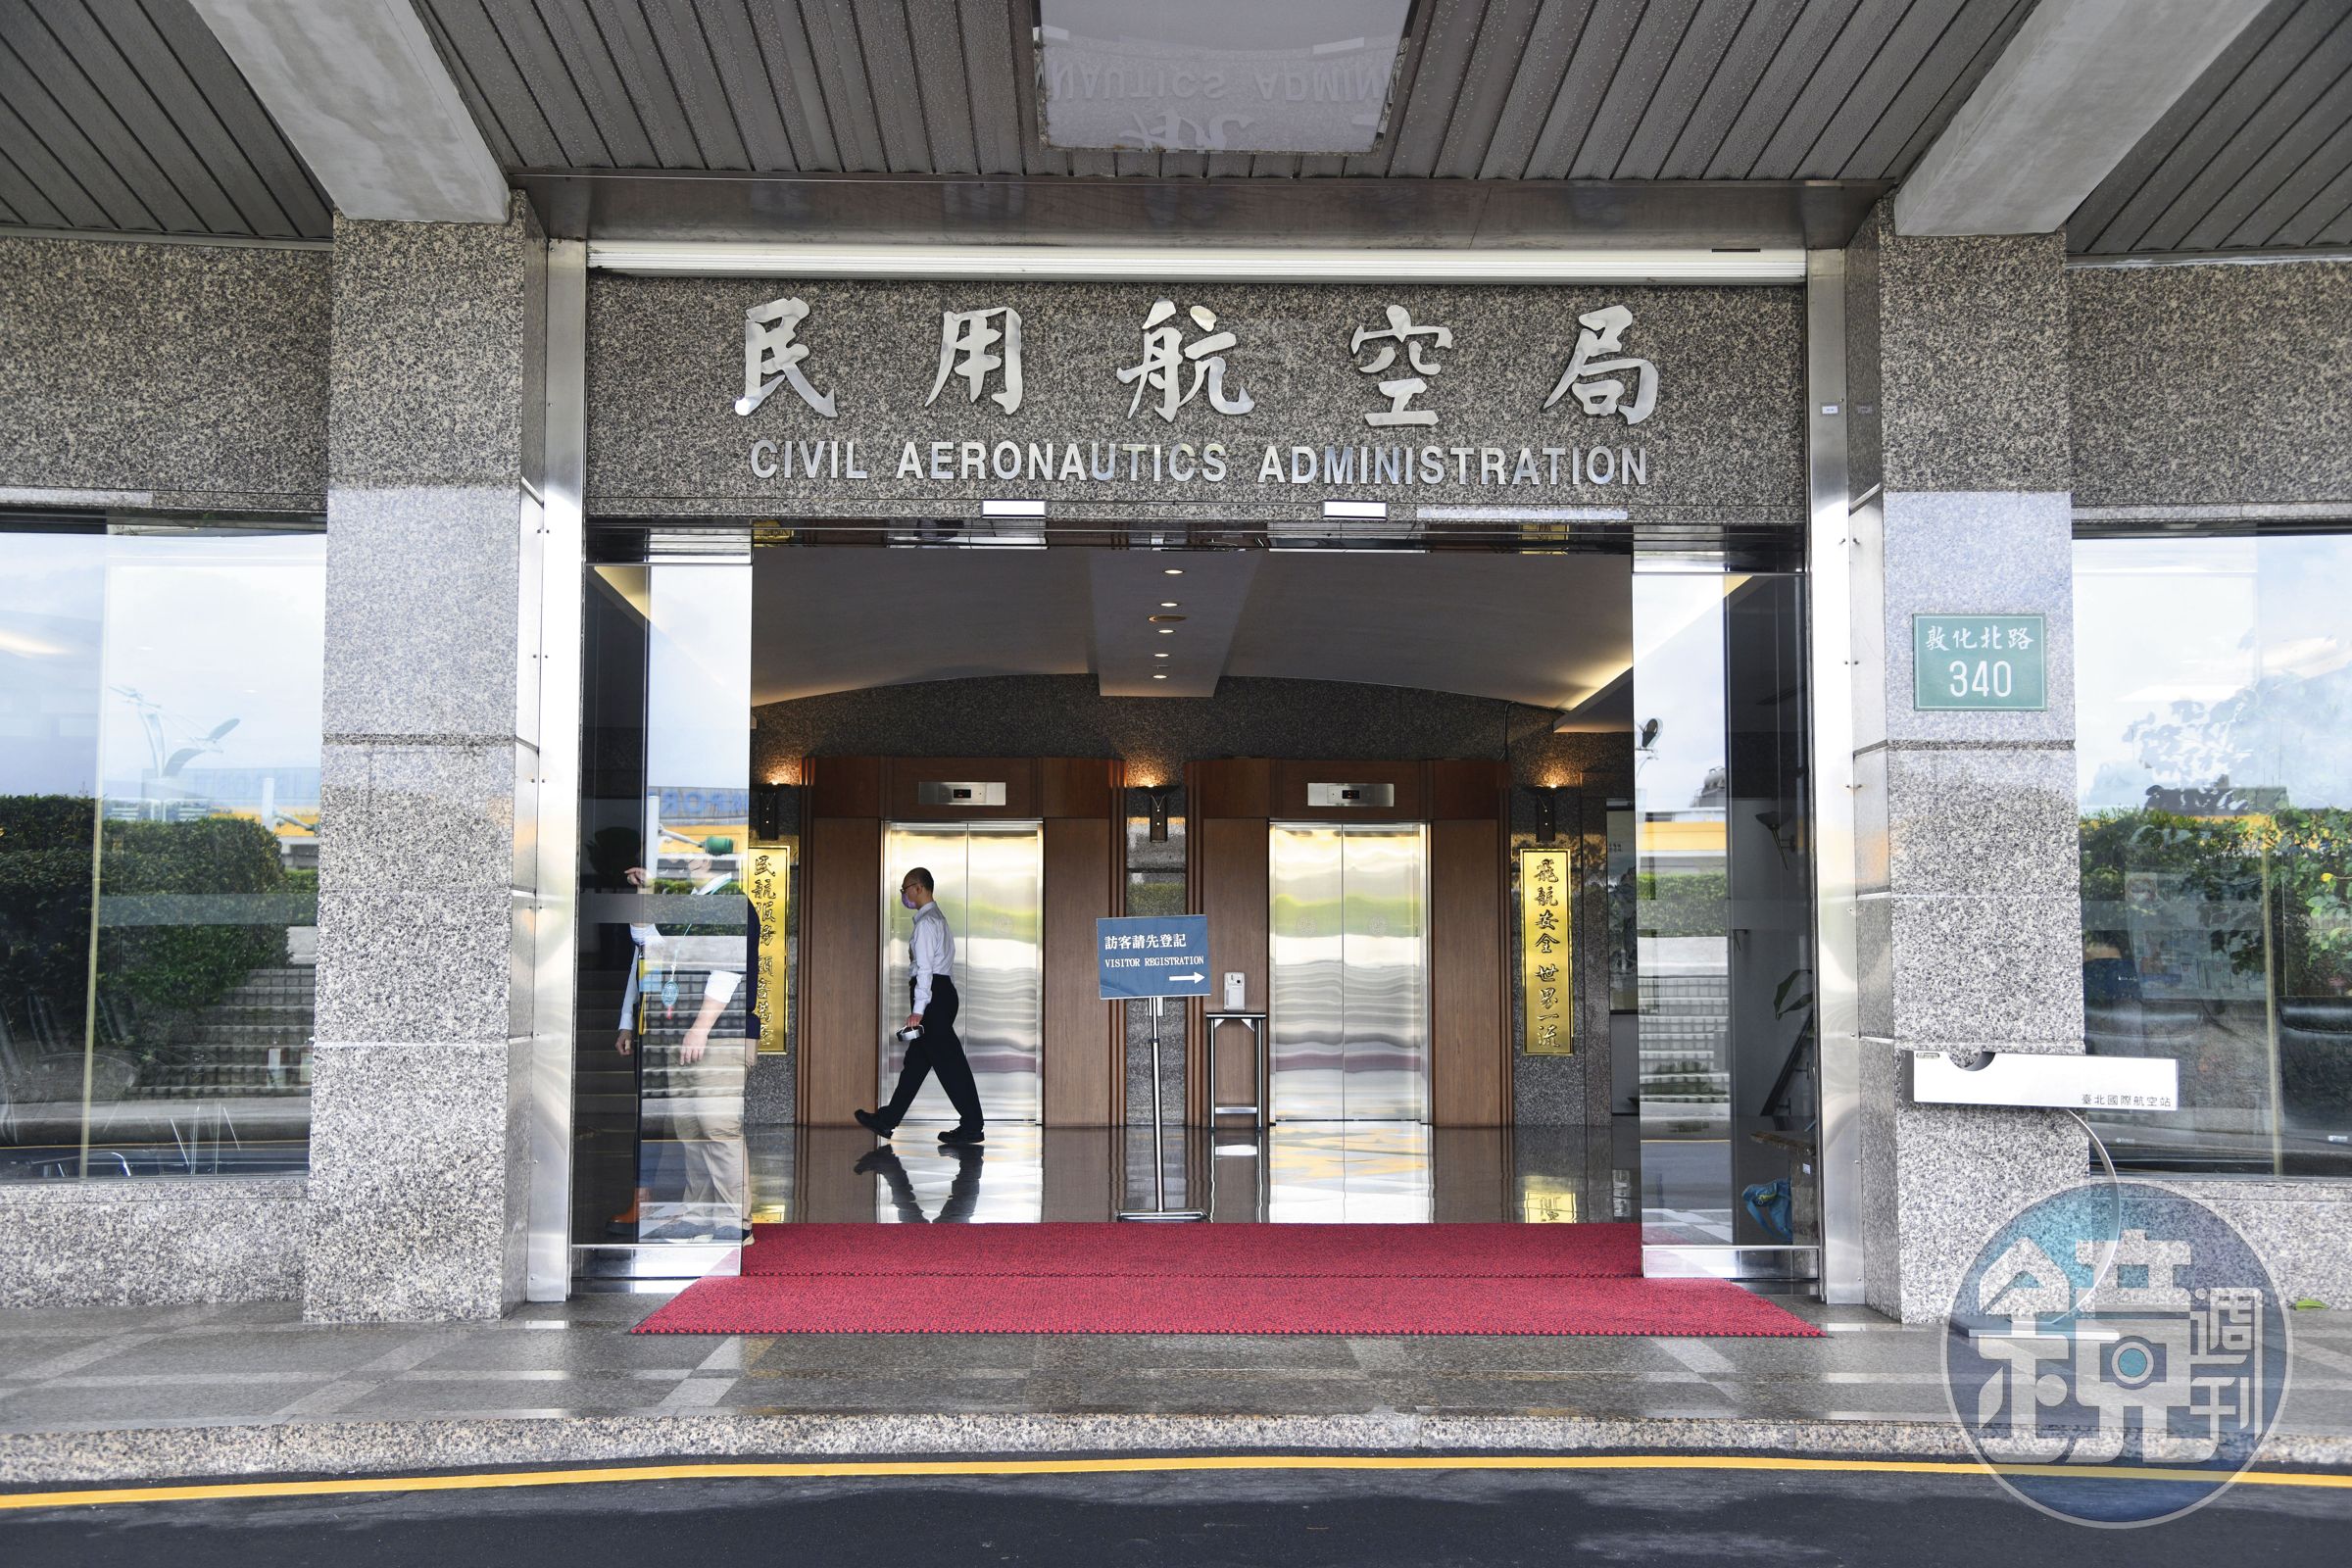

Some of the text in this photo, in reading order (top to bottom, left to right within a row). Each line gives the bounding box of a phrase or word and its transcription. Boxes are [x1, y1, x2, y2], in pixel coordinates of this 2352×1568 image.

[735, 296, 1659, 428] 民用航空局
[750, 438, 1647, 486] CIVIL AERONAUTICS ADMINISTRATION
[1925, 624, 2034, 652] 敦化北路
[1948, 660, 2012, 698] 340
[1103, 933, 1187, 951] 訪客請先登記
[1104, 956, 1204, 968] VISITOR REGISTRATION
[2082, 1094, 2172, 1107] 臺北國際航空站
